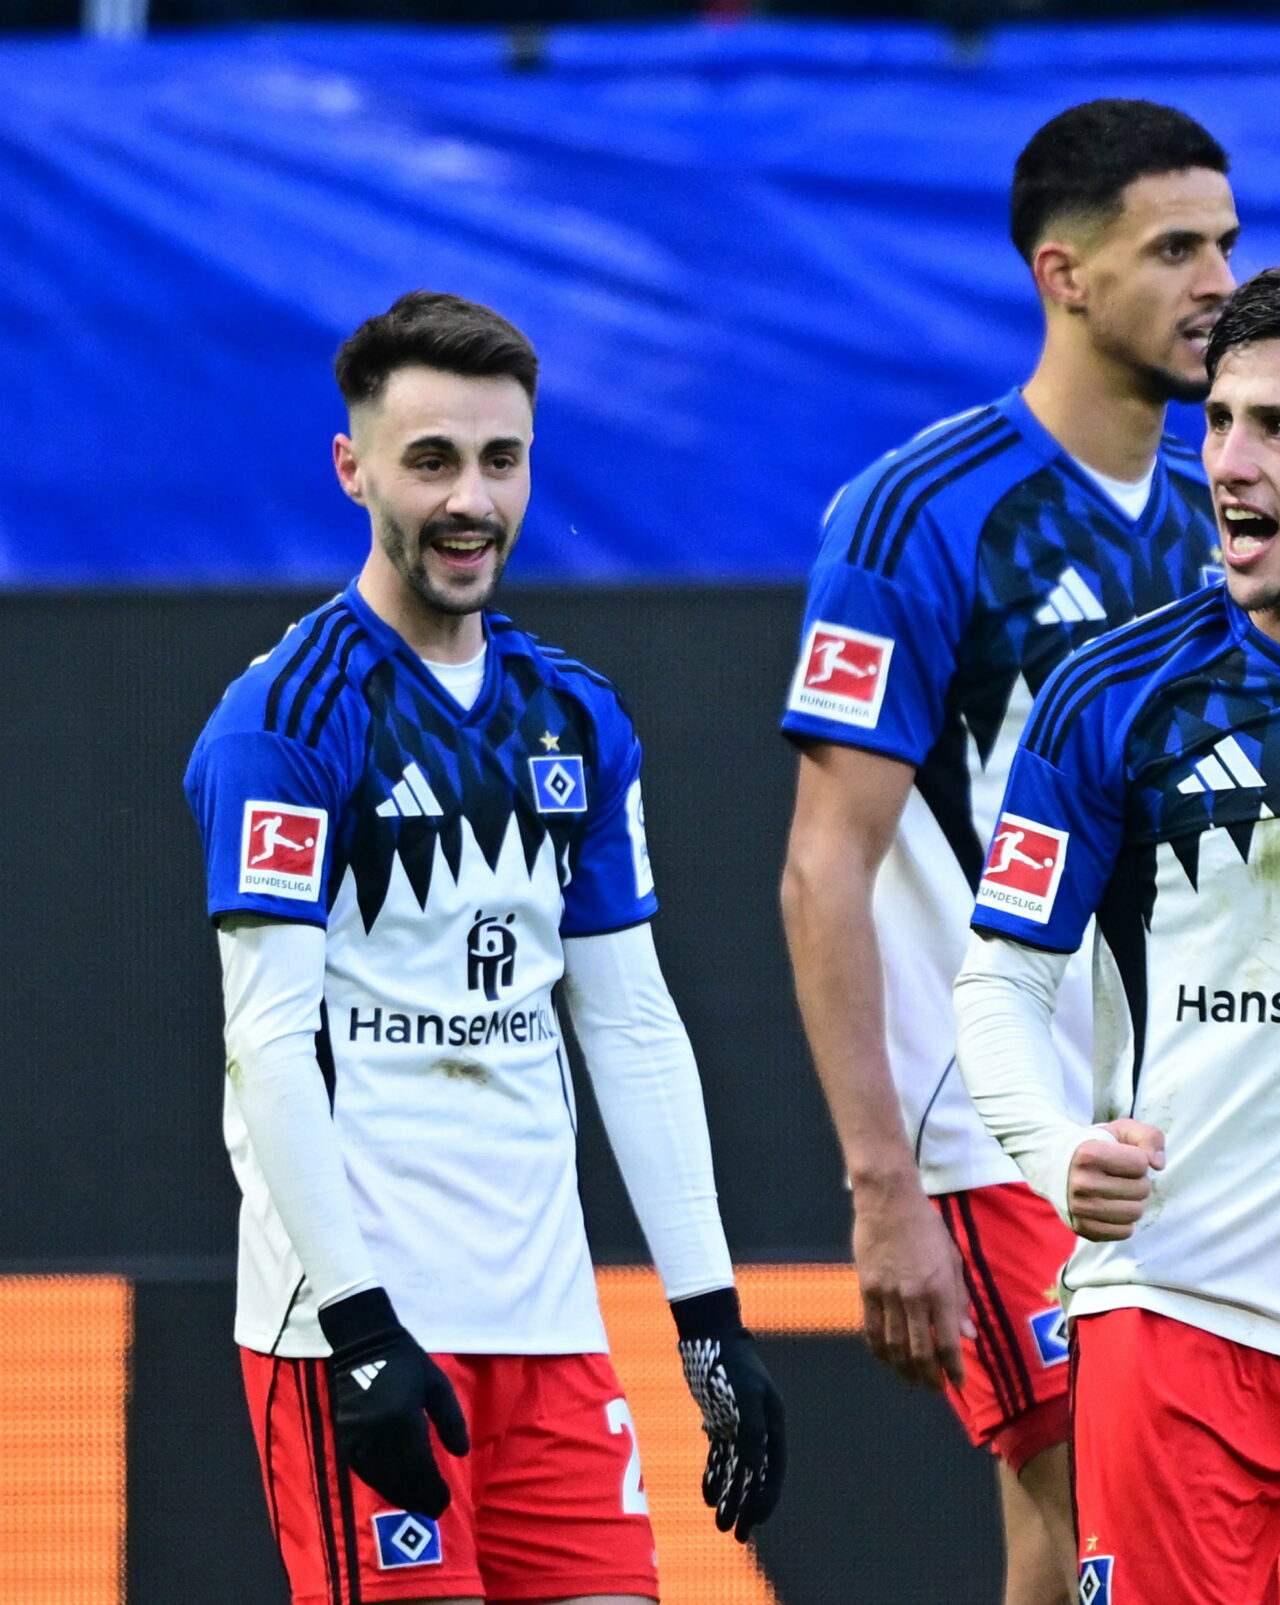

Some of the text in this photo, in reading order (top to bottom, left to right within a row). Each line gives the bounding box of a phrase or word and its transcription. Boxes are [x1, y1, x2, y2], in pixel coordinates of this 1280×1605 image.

[800, 694, 870, 718] BUNDESLIGA
[245, 875, 312, 892] BUNDESLIGA
[980, 886, 1043, 913] UNDESLIGA
